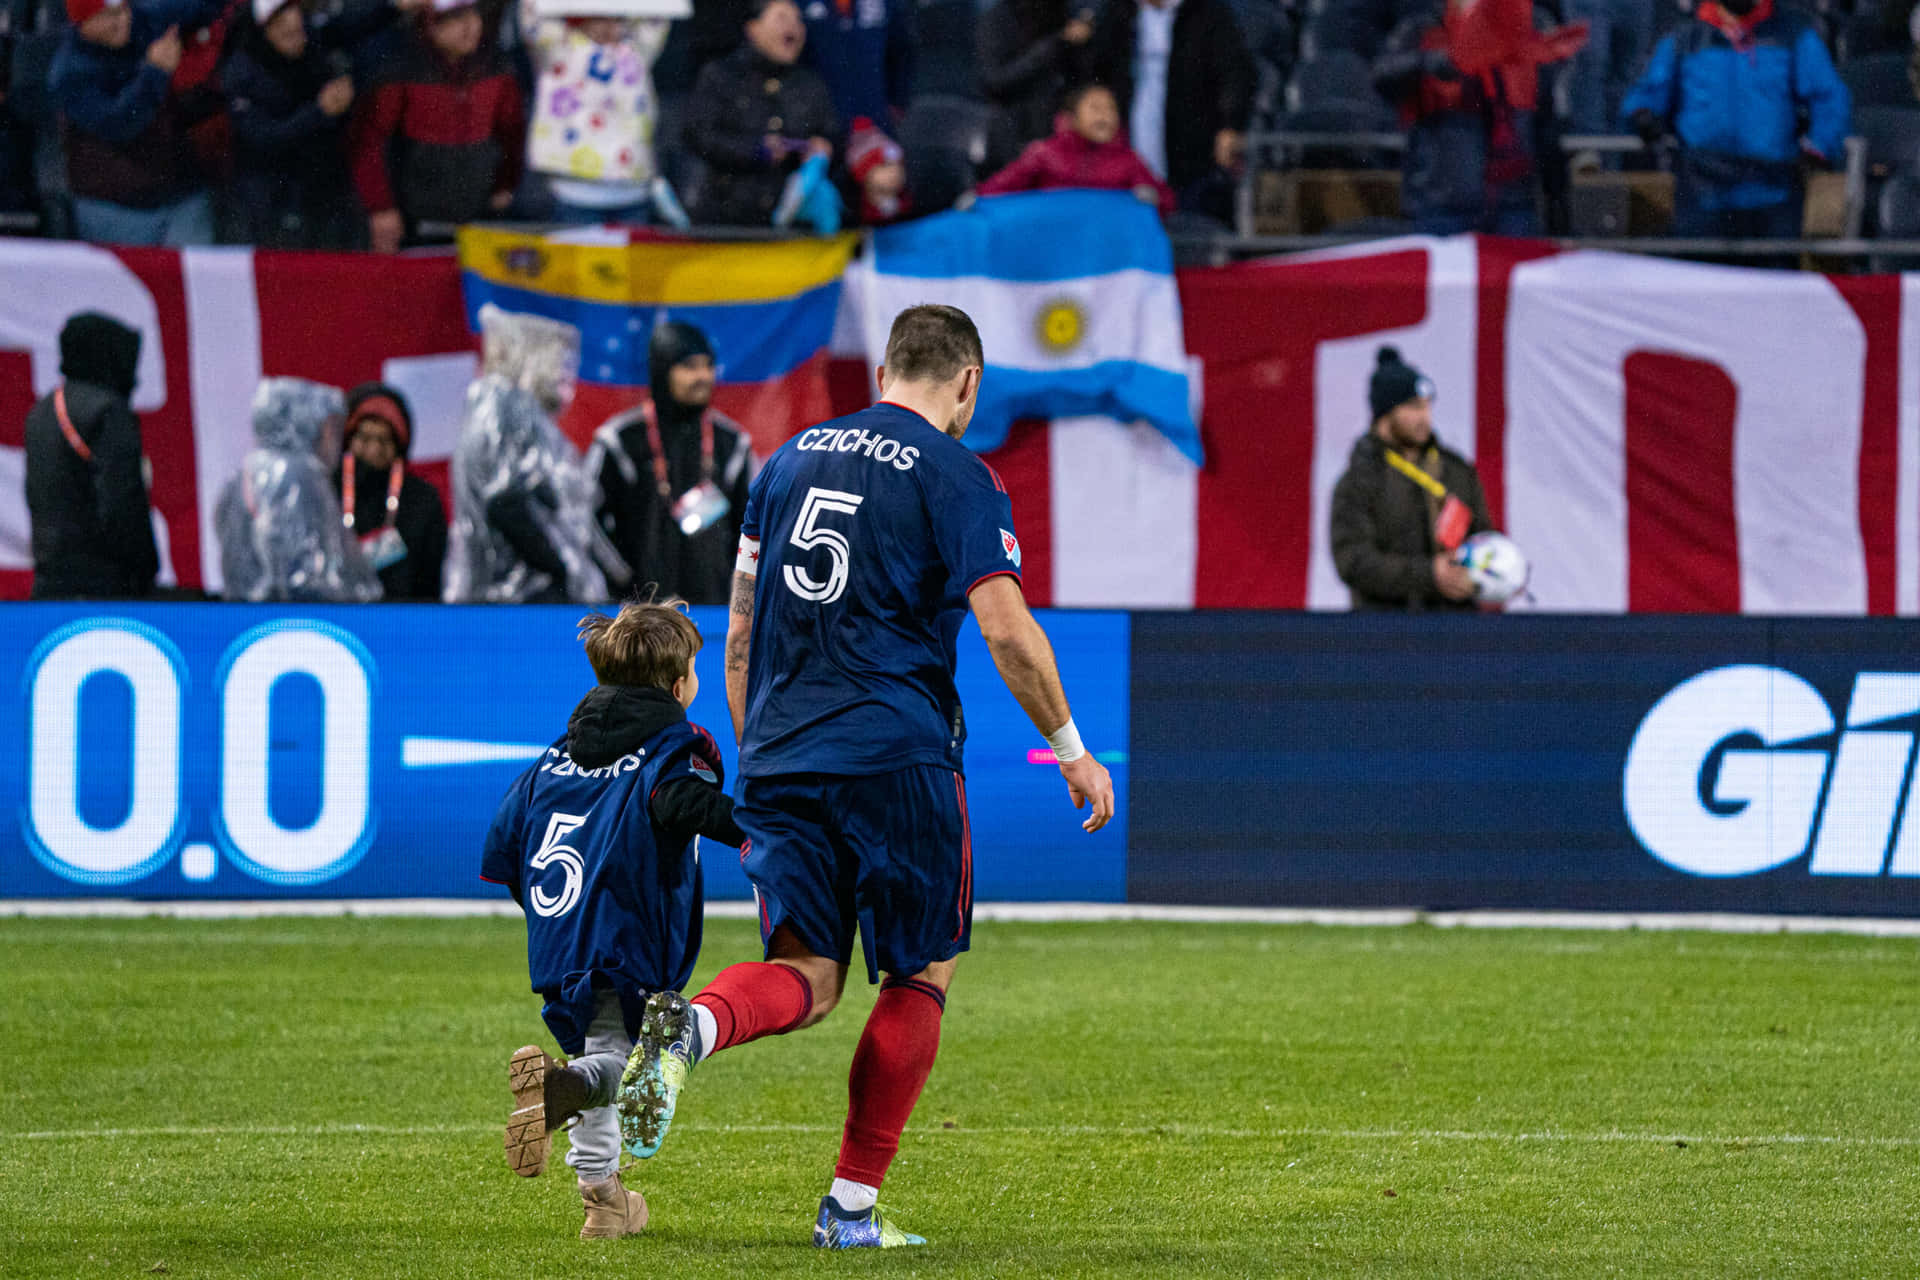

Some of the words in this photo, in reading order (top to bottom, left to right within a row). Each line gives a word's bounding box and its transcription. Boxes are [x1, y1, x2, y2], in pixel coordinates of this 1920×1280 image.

[797, 429, 920, 471] CZICHOS
[783, 486, 865, 605] 5
[28, 622, 374, 884] 0.0
[530, 812, 587, 918] 5
